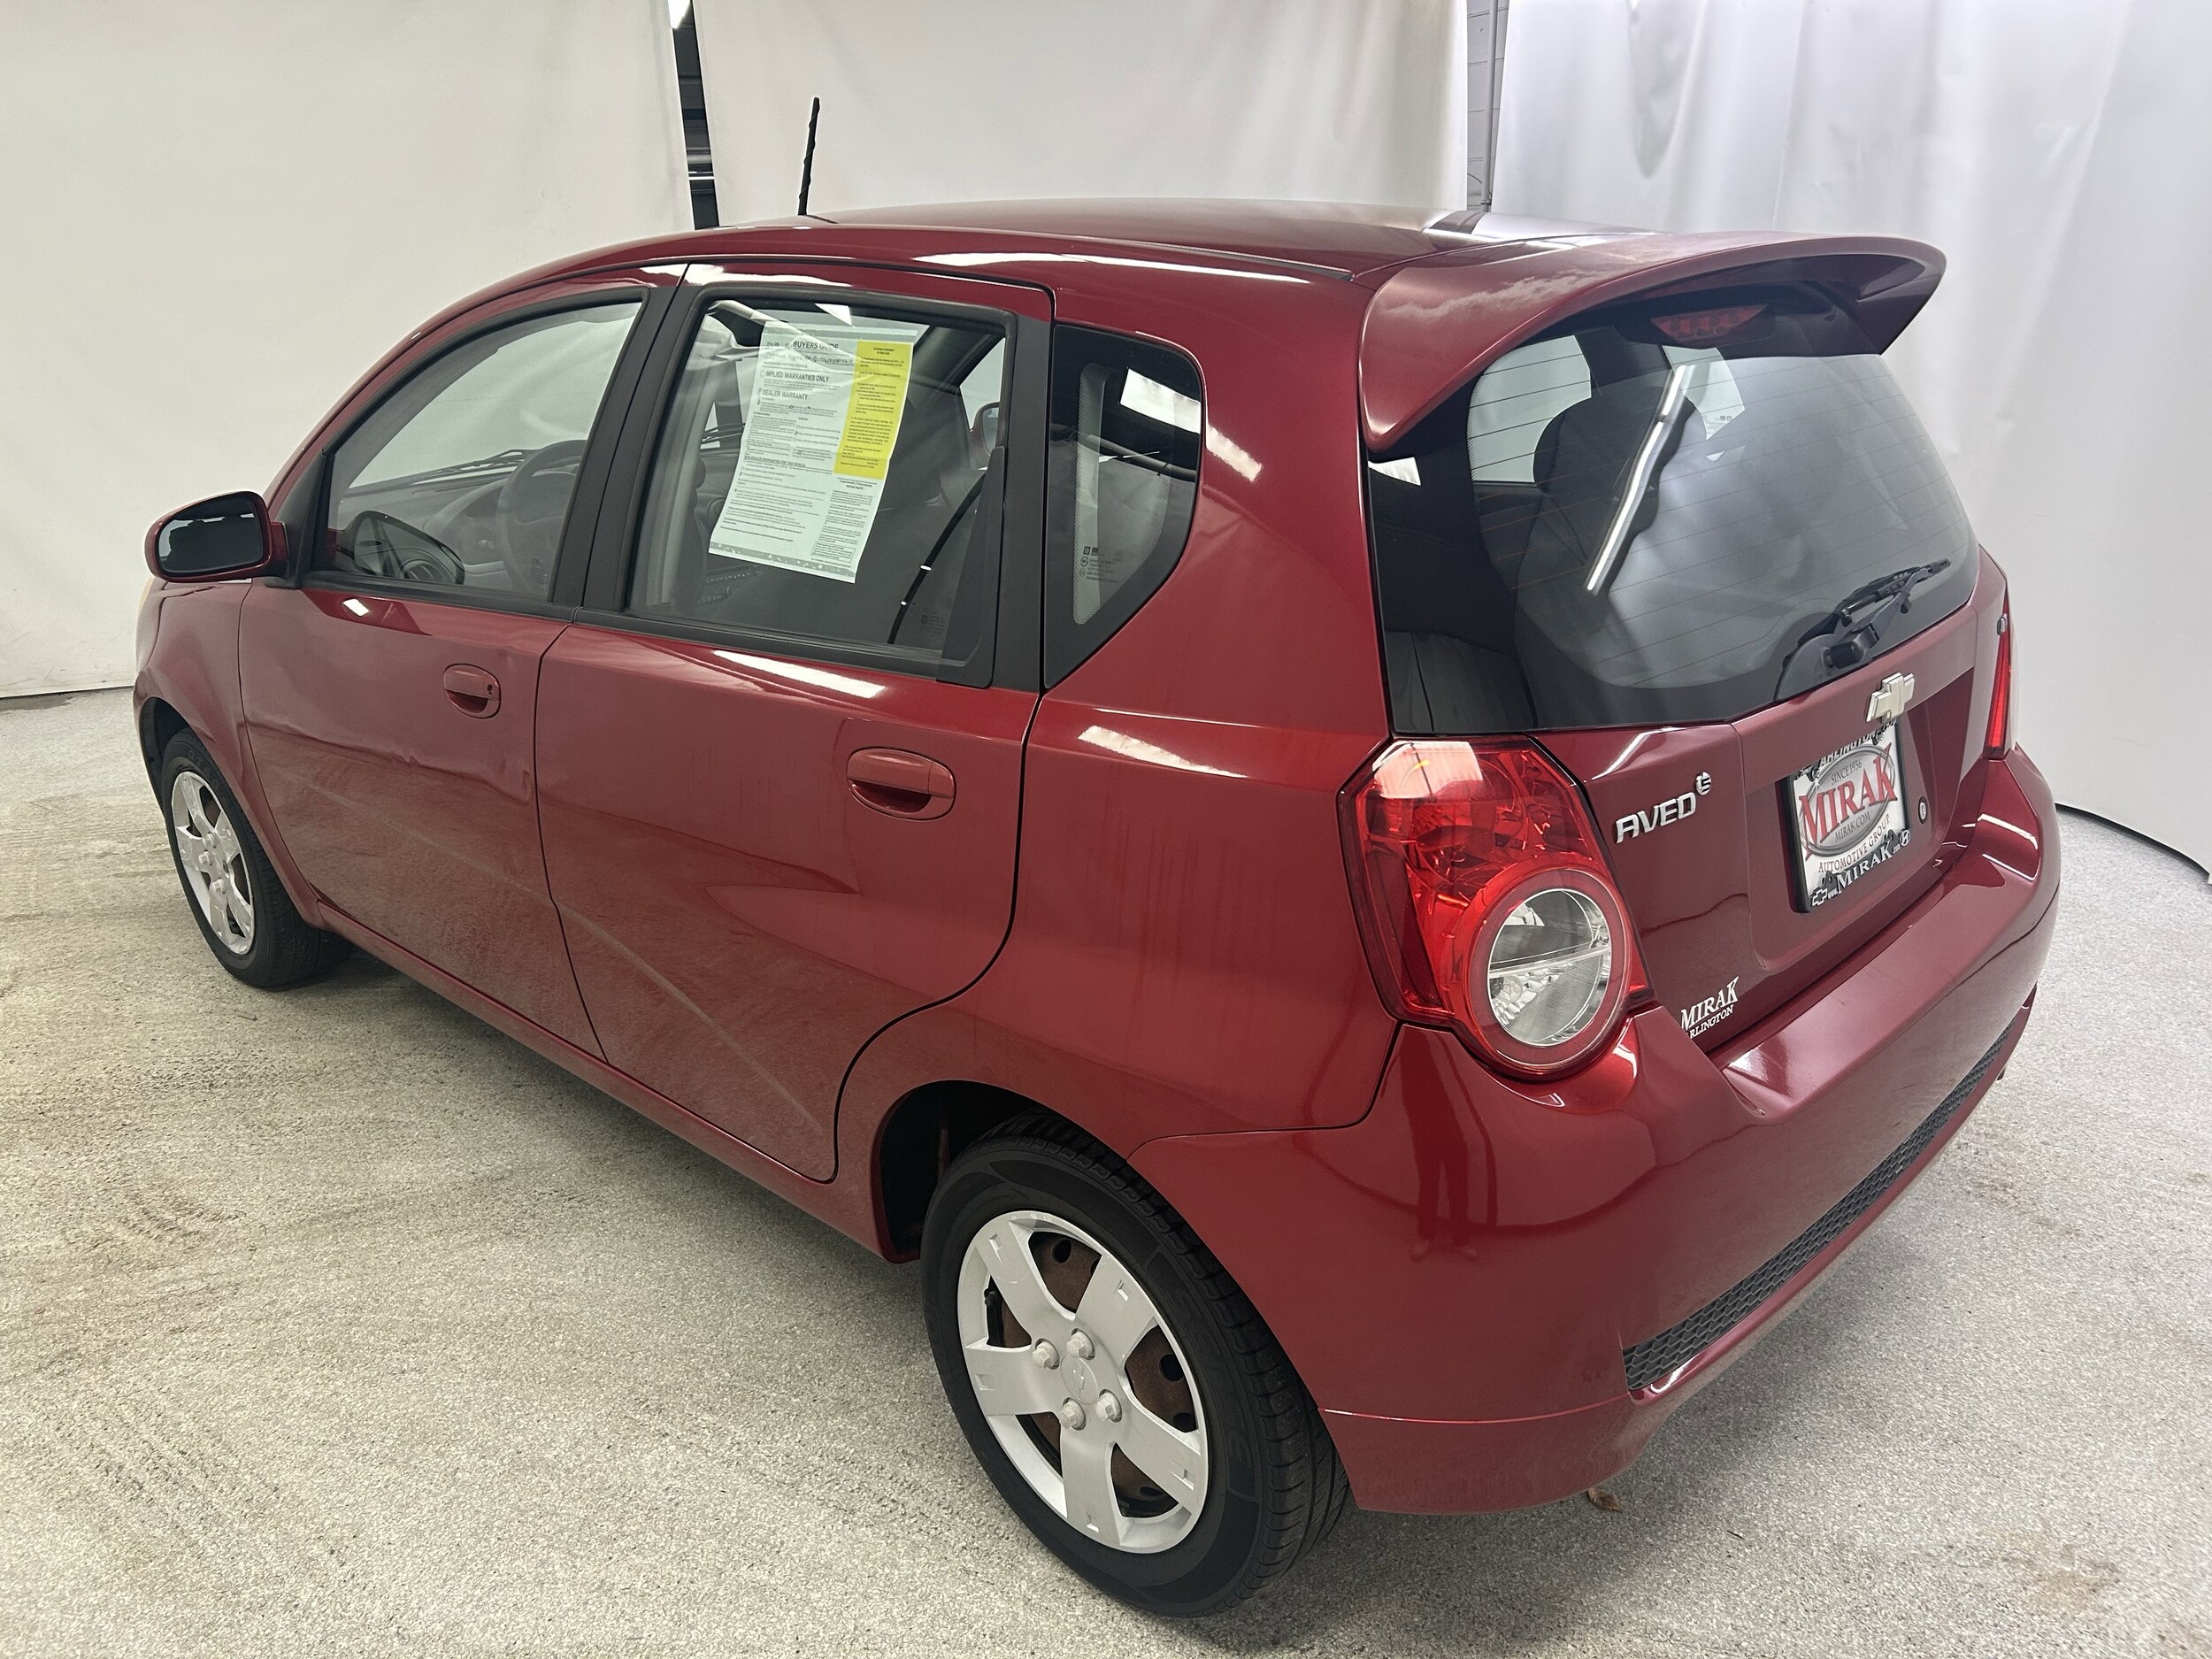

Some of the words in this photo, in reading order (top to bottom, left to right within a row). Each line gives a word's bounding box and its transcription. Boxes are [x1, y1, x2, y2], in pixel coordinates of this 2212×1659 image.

[793, 340, 818, 349] BUYERS
[819, 342, 840, 351] GUDE
[784, 372, 815, 382] WARRANTIES
[816, 374, 830, 383] ONLY
[781, 391, 809, 401] WARRANTY
[1831, 766, 1850, 786] SINCE
[1799, 741, 1898, 862] MIRAK
[1835, 810, 1871, 843] MIRAK.COM
[1818, 842, 1868, 873] AUTOMOTIVE
[1869, 814, 1891, 847] GROUP
[1681, 976, 1740, 1031] MIRAK
[1686, 1003, 1734, 1040] RLINGTON
